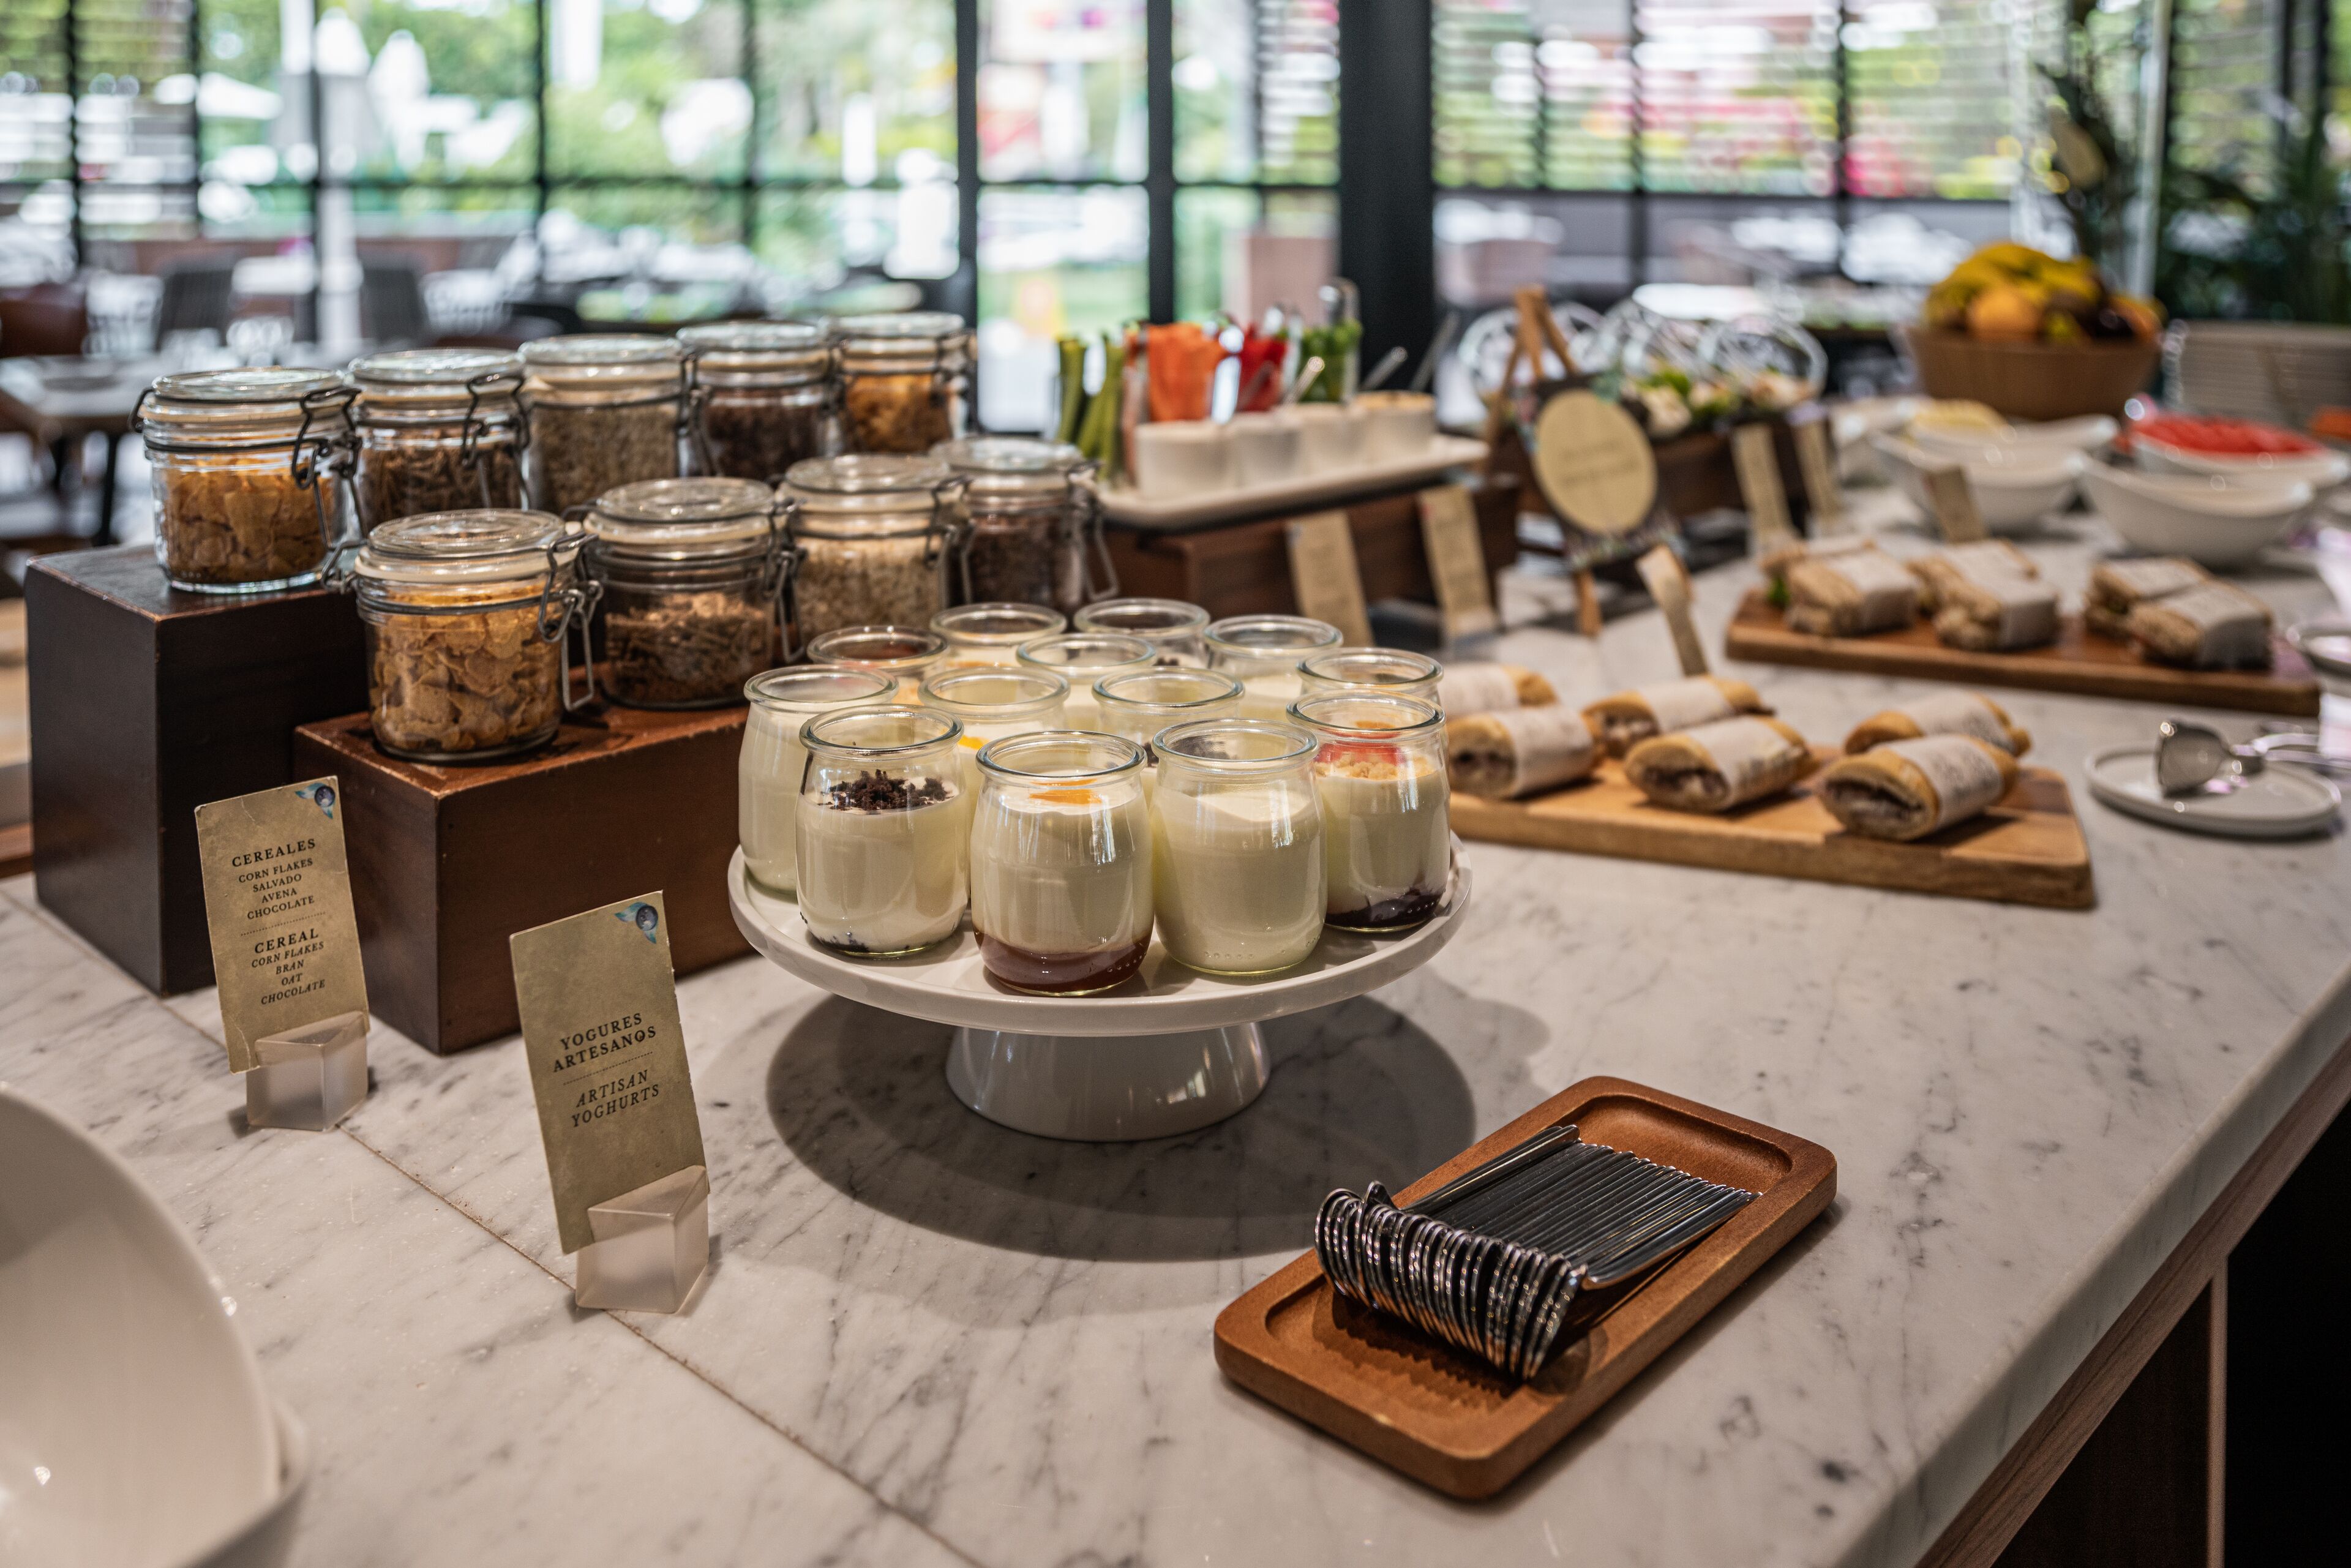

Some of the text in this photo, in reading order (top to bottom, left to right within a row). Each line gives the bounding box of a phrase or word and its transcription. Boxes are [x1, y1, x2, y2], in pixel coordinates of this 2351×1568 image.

[232, 839, 315, 867] CEREALES
[239, 858, 313, 883] CORN FLAKES
[253, 874, 302, 893] SALVADO
[261, 888, 297, 903] AVENA
[247, 895, 315, 919] CHOCOLATE
[255, 929, 318, 953] CEREAL
[252, 941, 324, 968] CORN FLAKES
[276, 959, 304, 975] BRAN
[281, 973, 302, 986] OAT
[261, 980, 325, 1004] CHOCOLATE
[560, 1013, 642, 1050] YOGURES
[553, 1026, 656, 1072] ARTESANOS
[576, 1070, 648, 1108] ARTISAN
[571, 1084, 659, 1127] YOGHURTS
